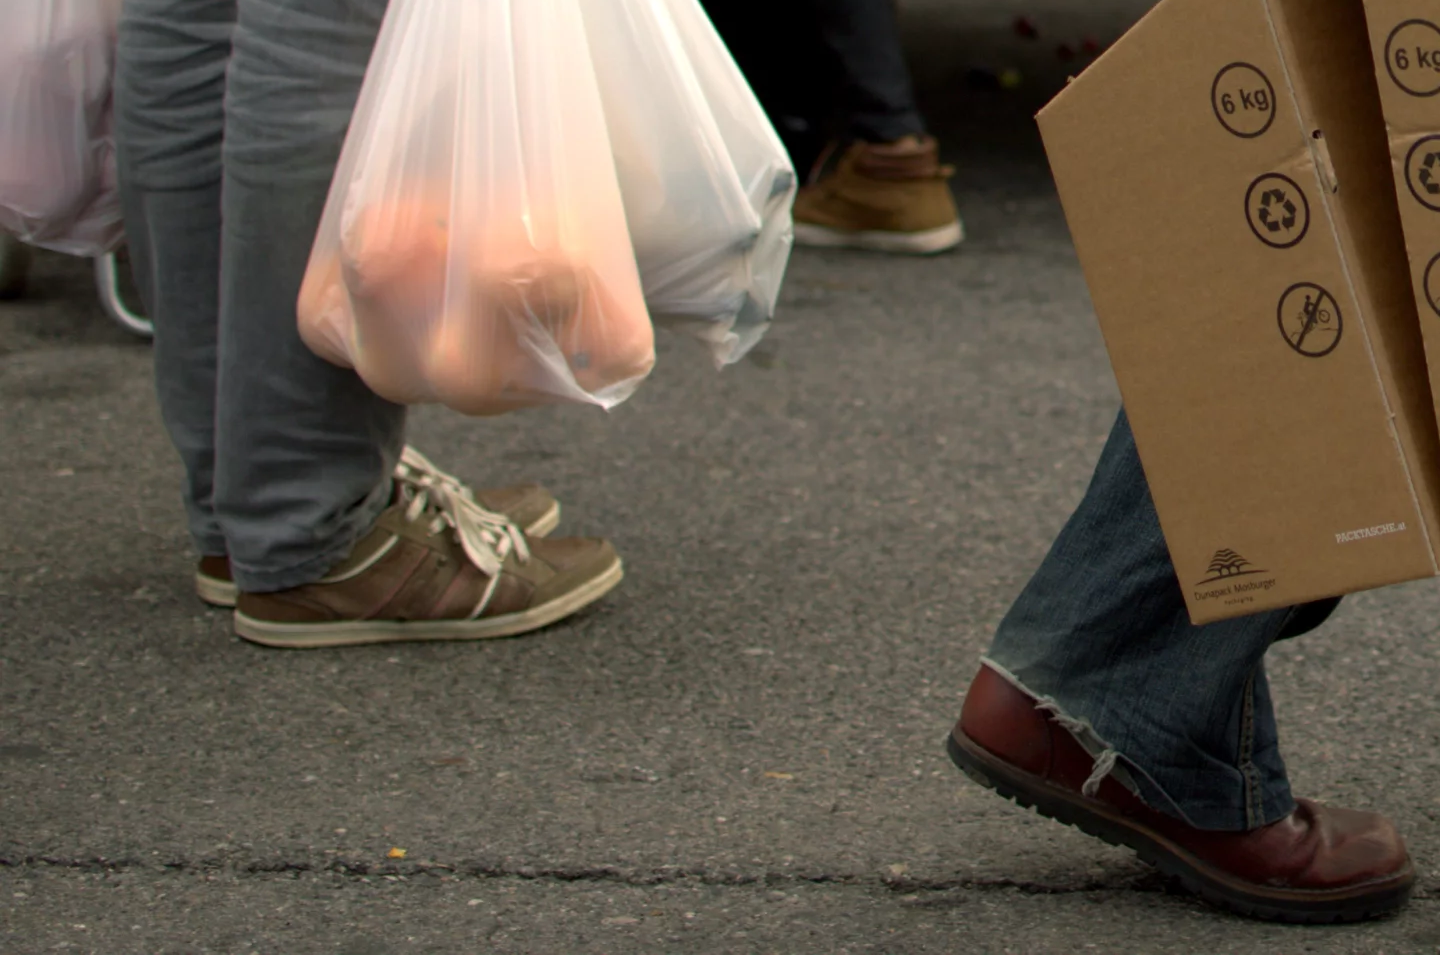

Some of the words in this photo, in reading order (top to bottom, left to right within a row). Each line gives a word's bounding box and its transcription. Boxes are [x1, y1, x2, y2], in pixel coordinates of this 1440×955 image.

[1395, 48, 1409, 70] 6
[1221, 93, 1236, 114] 6
[1239, 88, 1269, 111] kg
[1193, 585, 1232, 601] Dunapack
[1234, 578, 1276, 593] Mosburger
